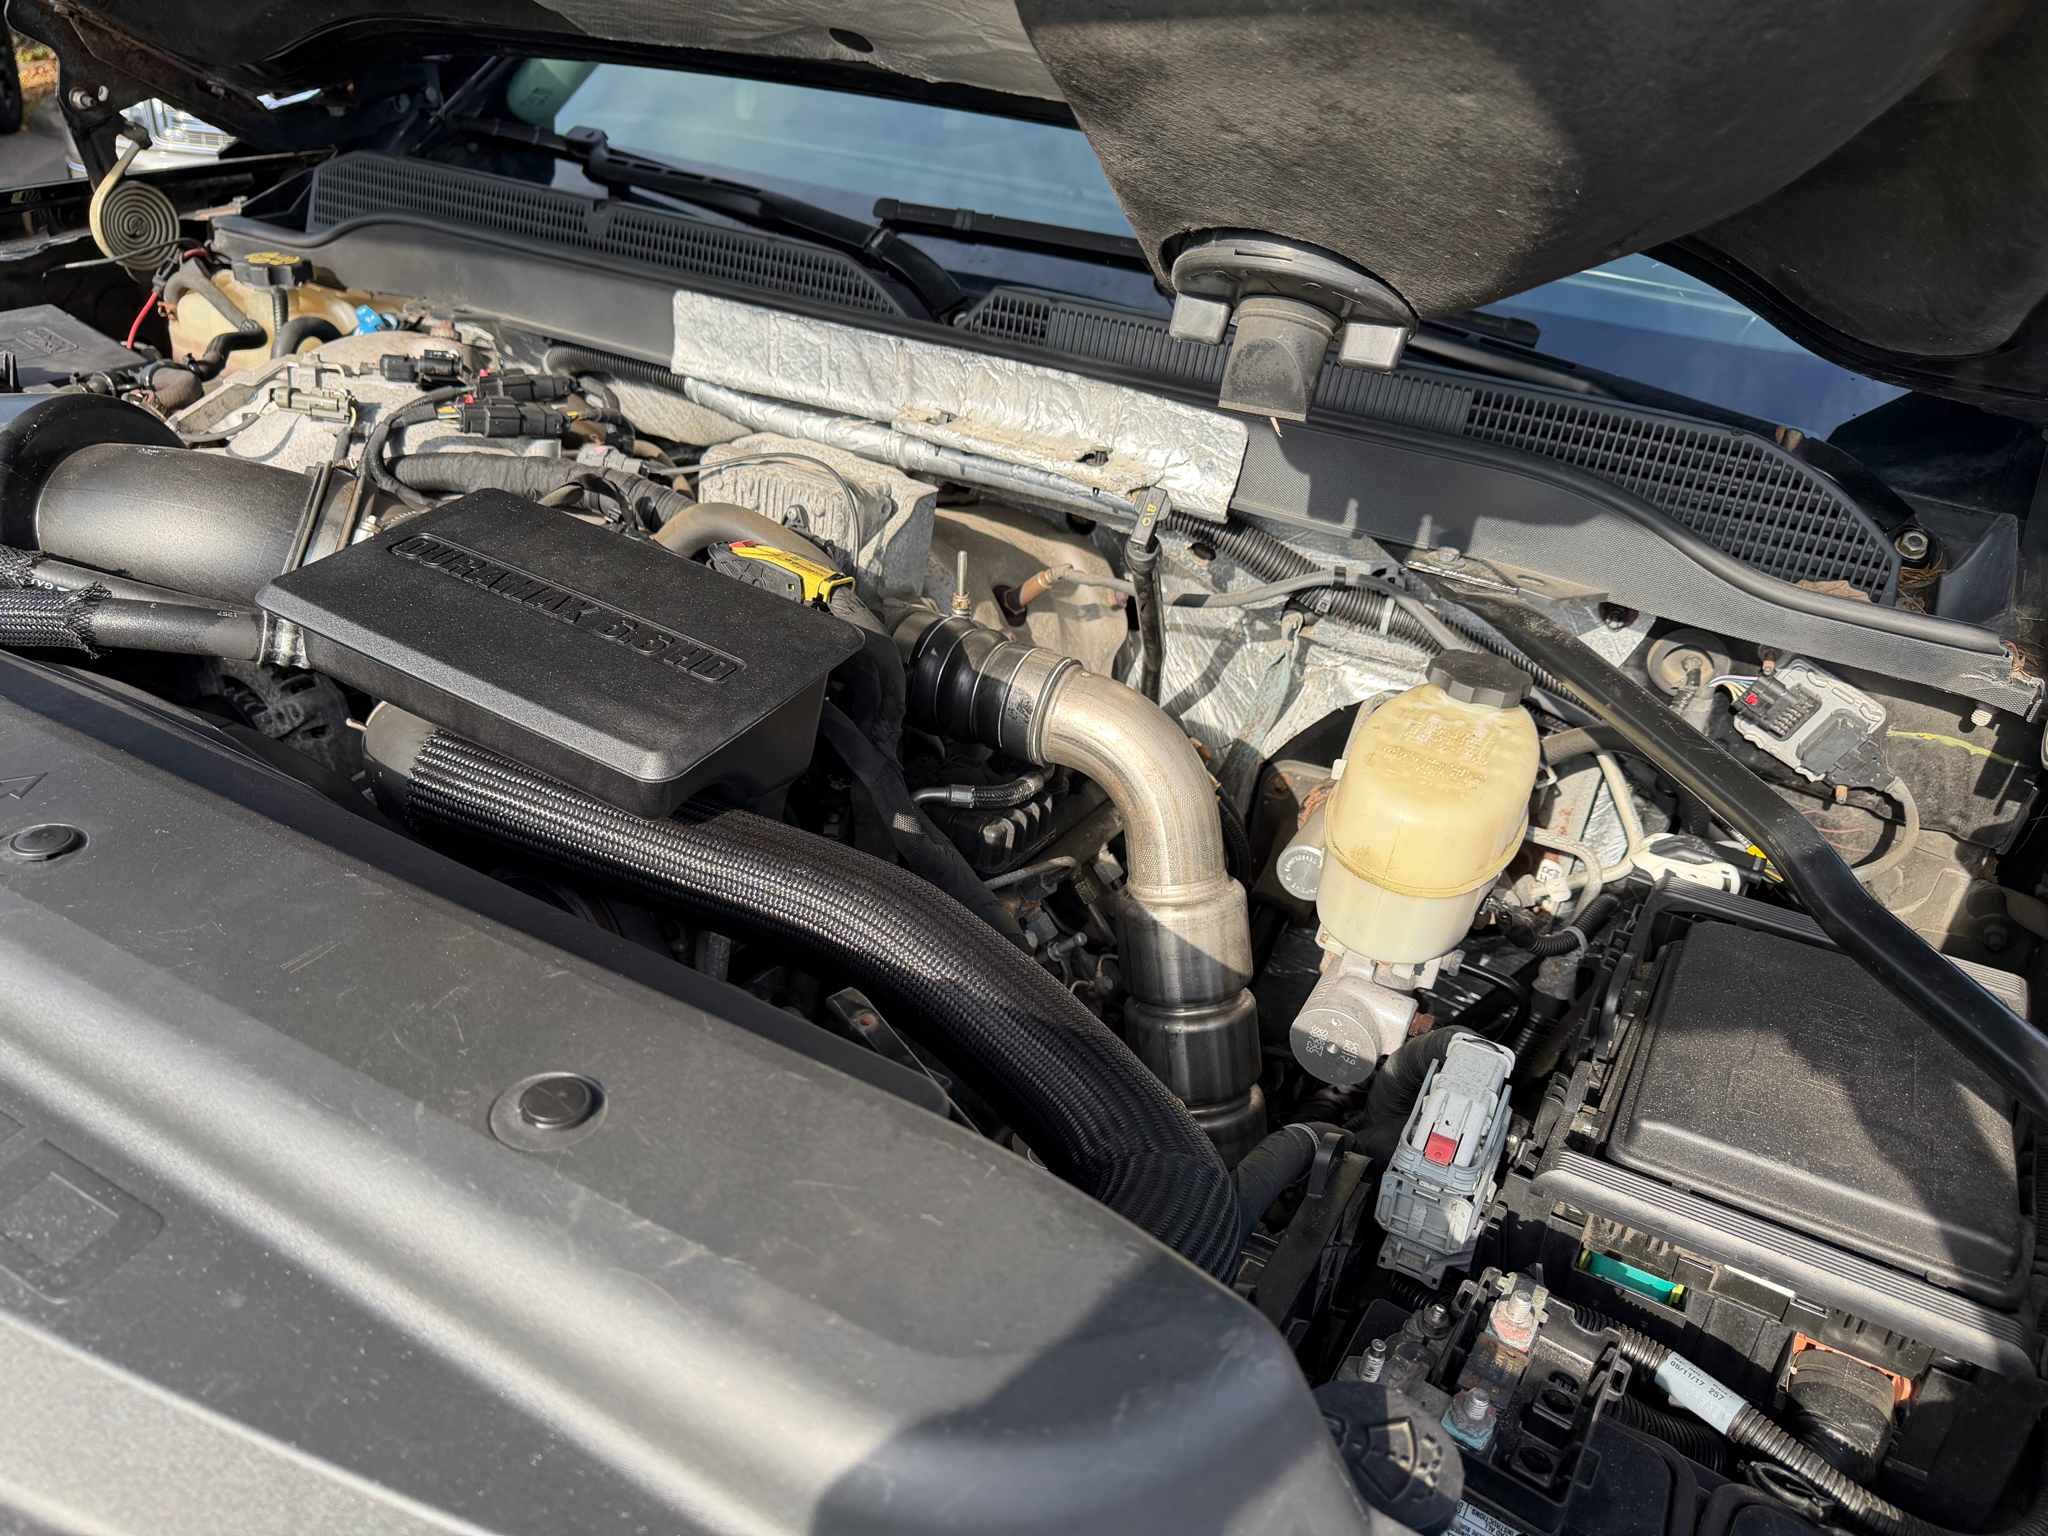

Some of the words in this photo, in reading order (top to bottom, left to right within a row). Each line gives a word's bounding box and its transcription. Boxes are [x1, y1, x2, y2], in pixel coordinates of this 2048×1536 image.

[389, 535, 602, 626] DURAMAX
[662, 645, 738, 684] HD
[1708, 1387, 1725, 1401] 257
